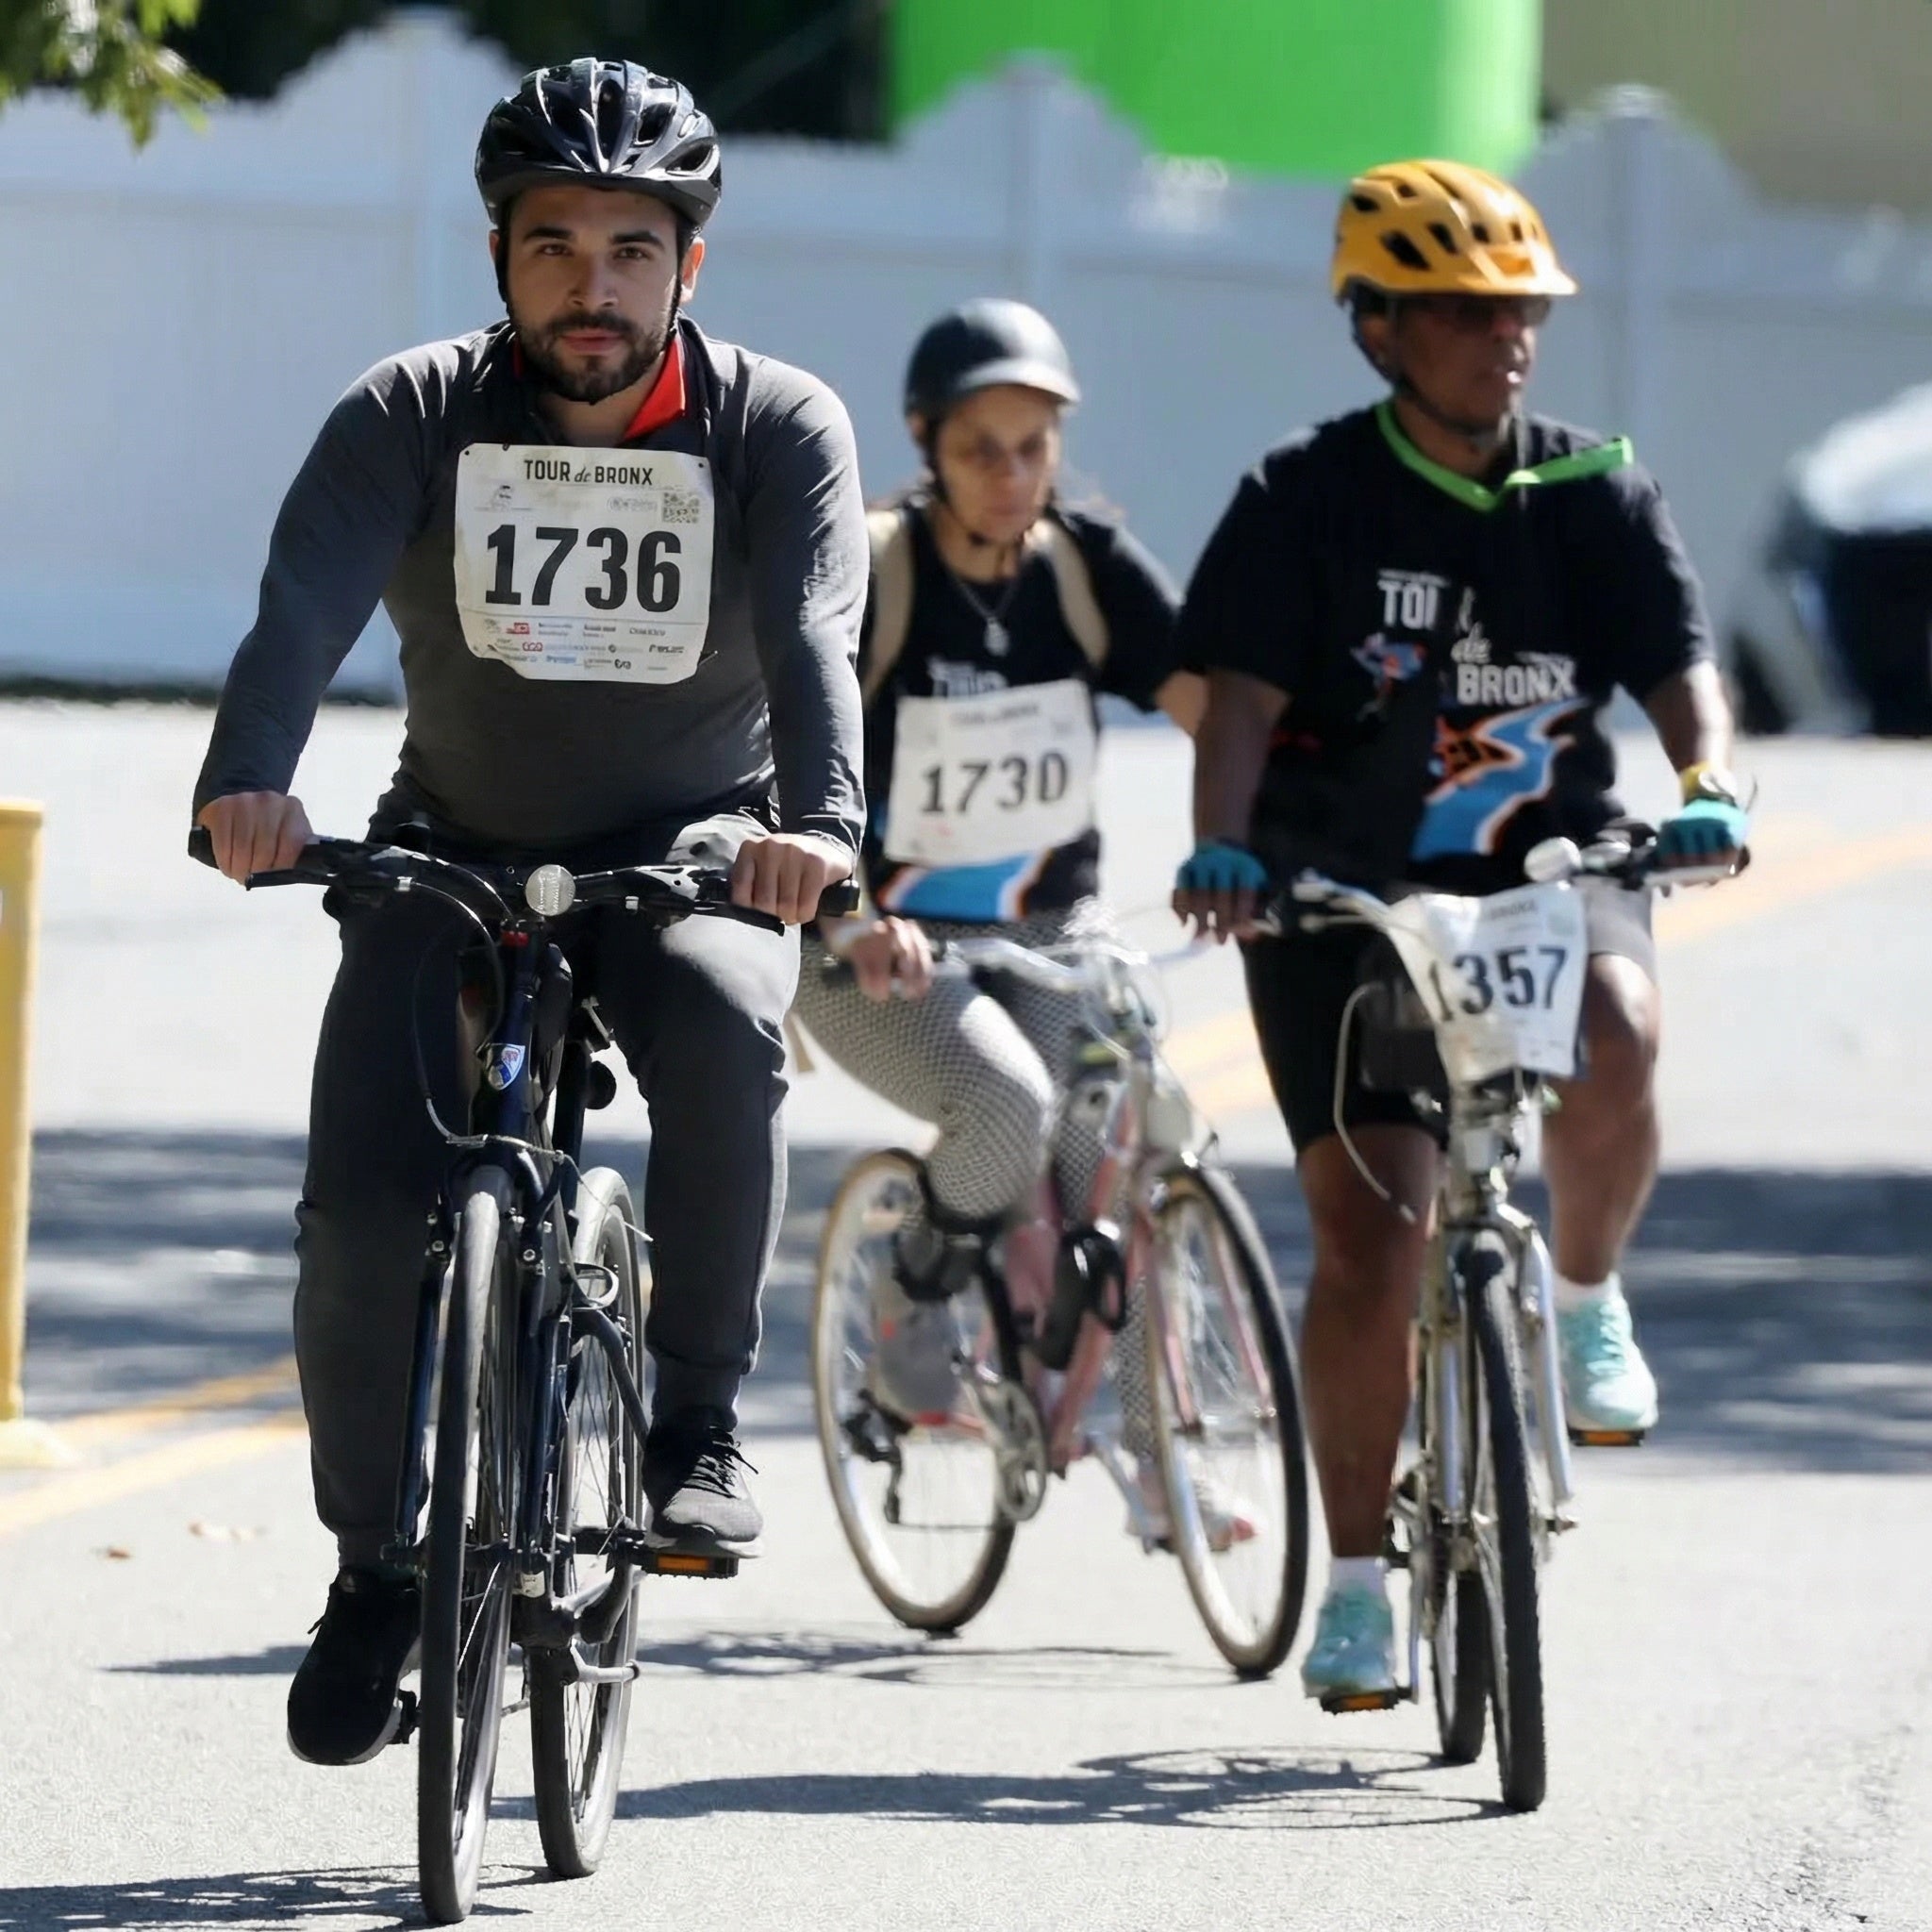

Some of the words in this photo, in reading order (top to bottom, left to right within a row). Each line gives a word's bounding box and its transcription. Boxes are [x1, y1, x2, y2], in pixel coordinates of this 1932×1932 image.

[524, 459, 571, 482] TOUR
[574, 466, 591, 483] de
[594, 466, 654, 486] BRONX
[485, 524, 681, 612] 1736
[1457, 662, 1578, 706] BRONX
[921, 751, 1069, 814] 1730
